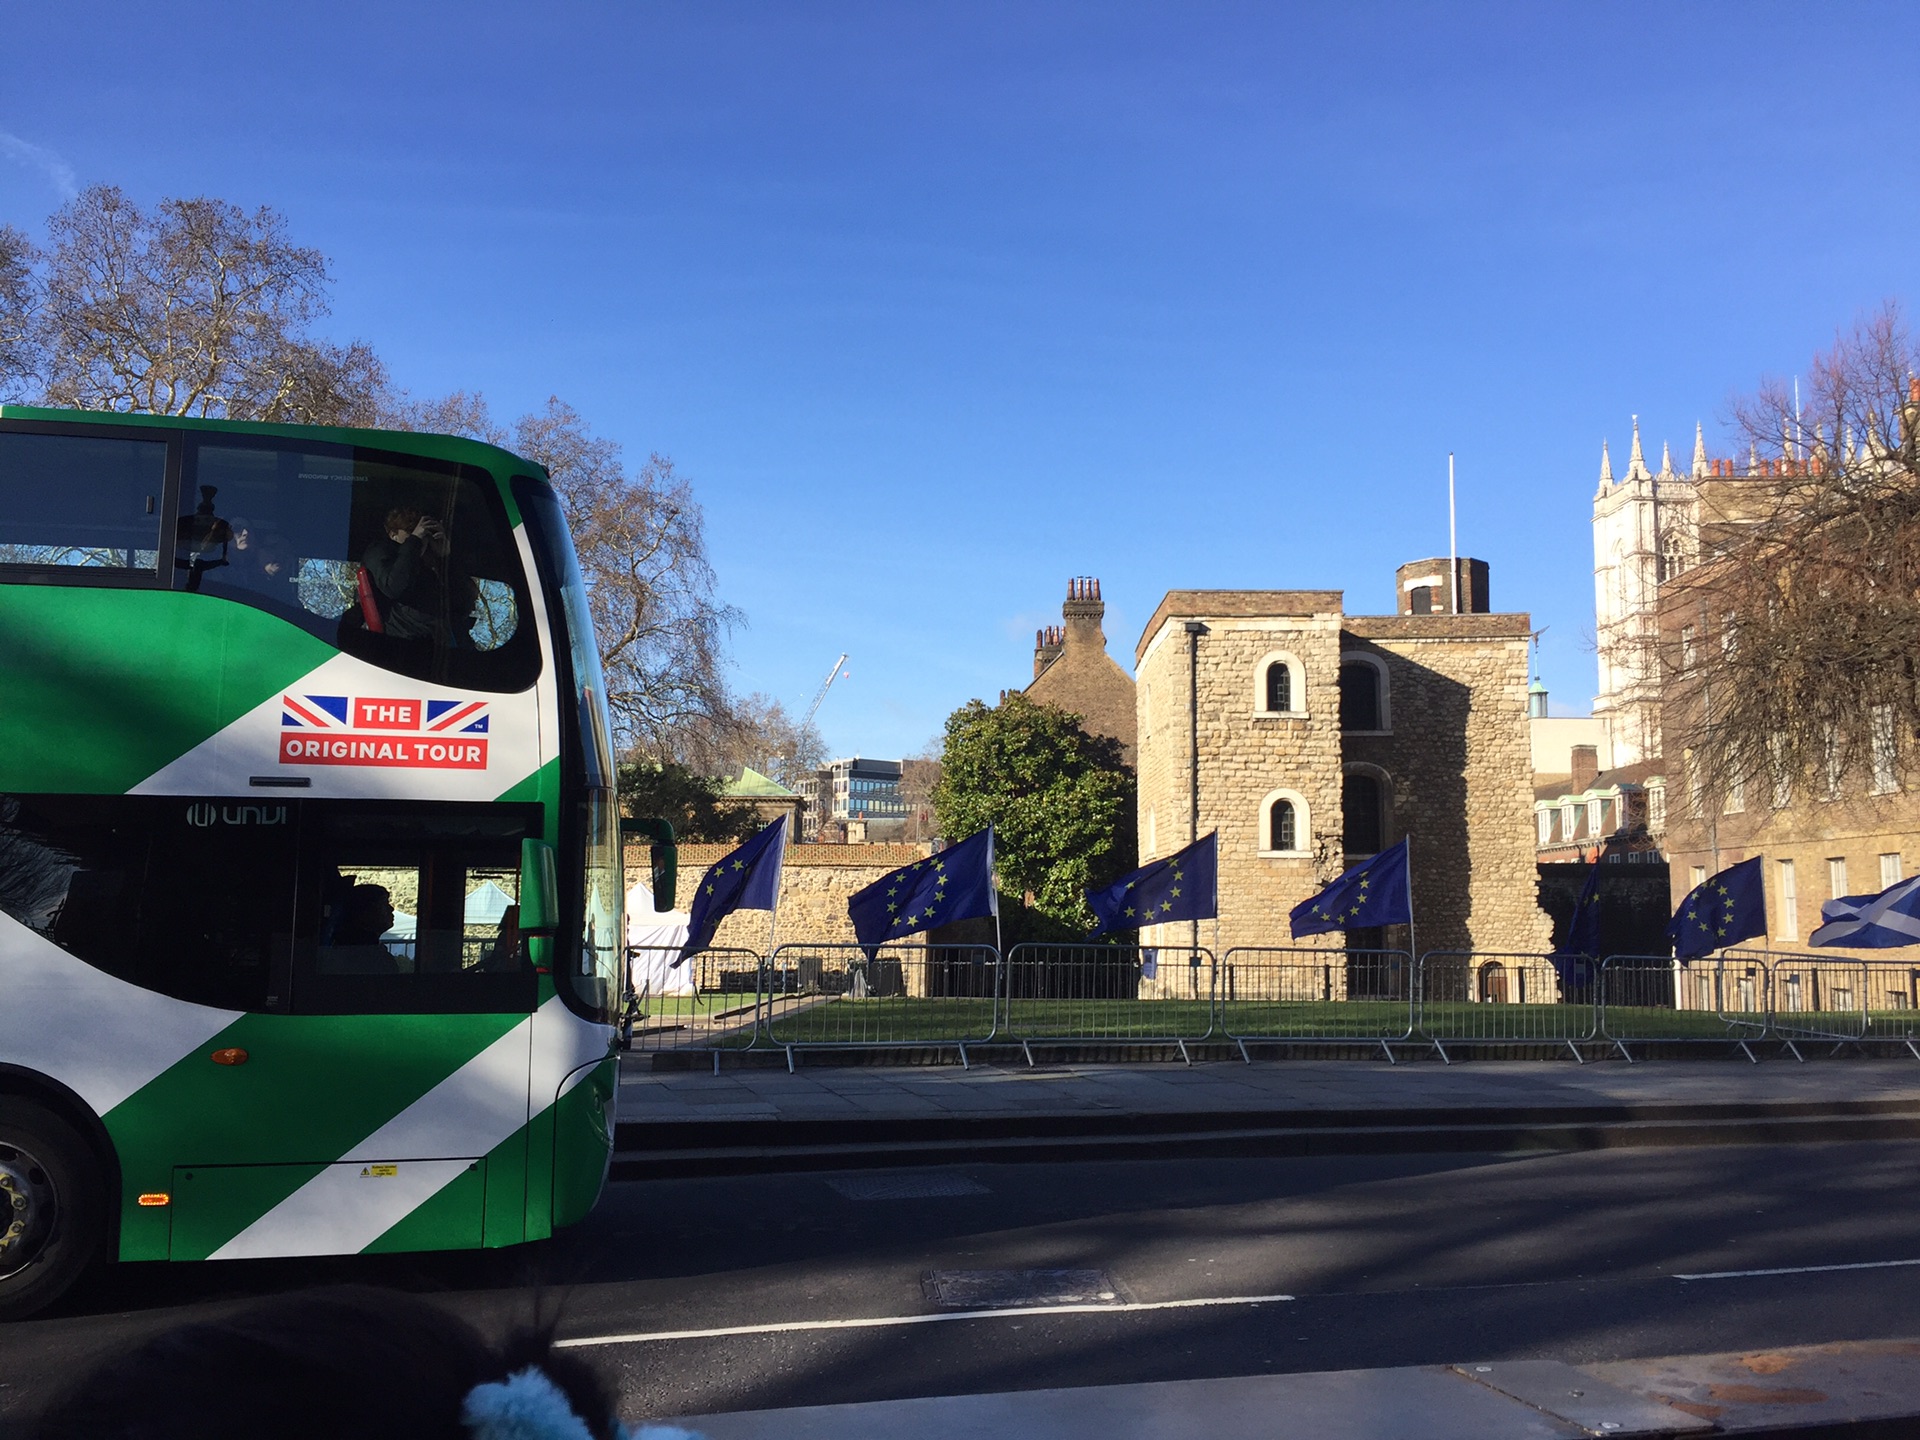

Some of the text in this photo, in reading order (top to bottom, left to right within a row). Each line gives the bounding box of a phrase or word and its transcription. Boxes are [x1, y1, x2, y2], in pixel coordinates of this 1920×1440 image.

[362, 704, 412, 723] THE
[285, 739, 481, 763] ORIGINAL TOUR
